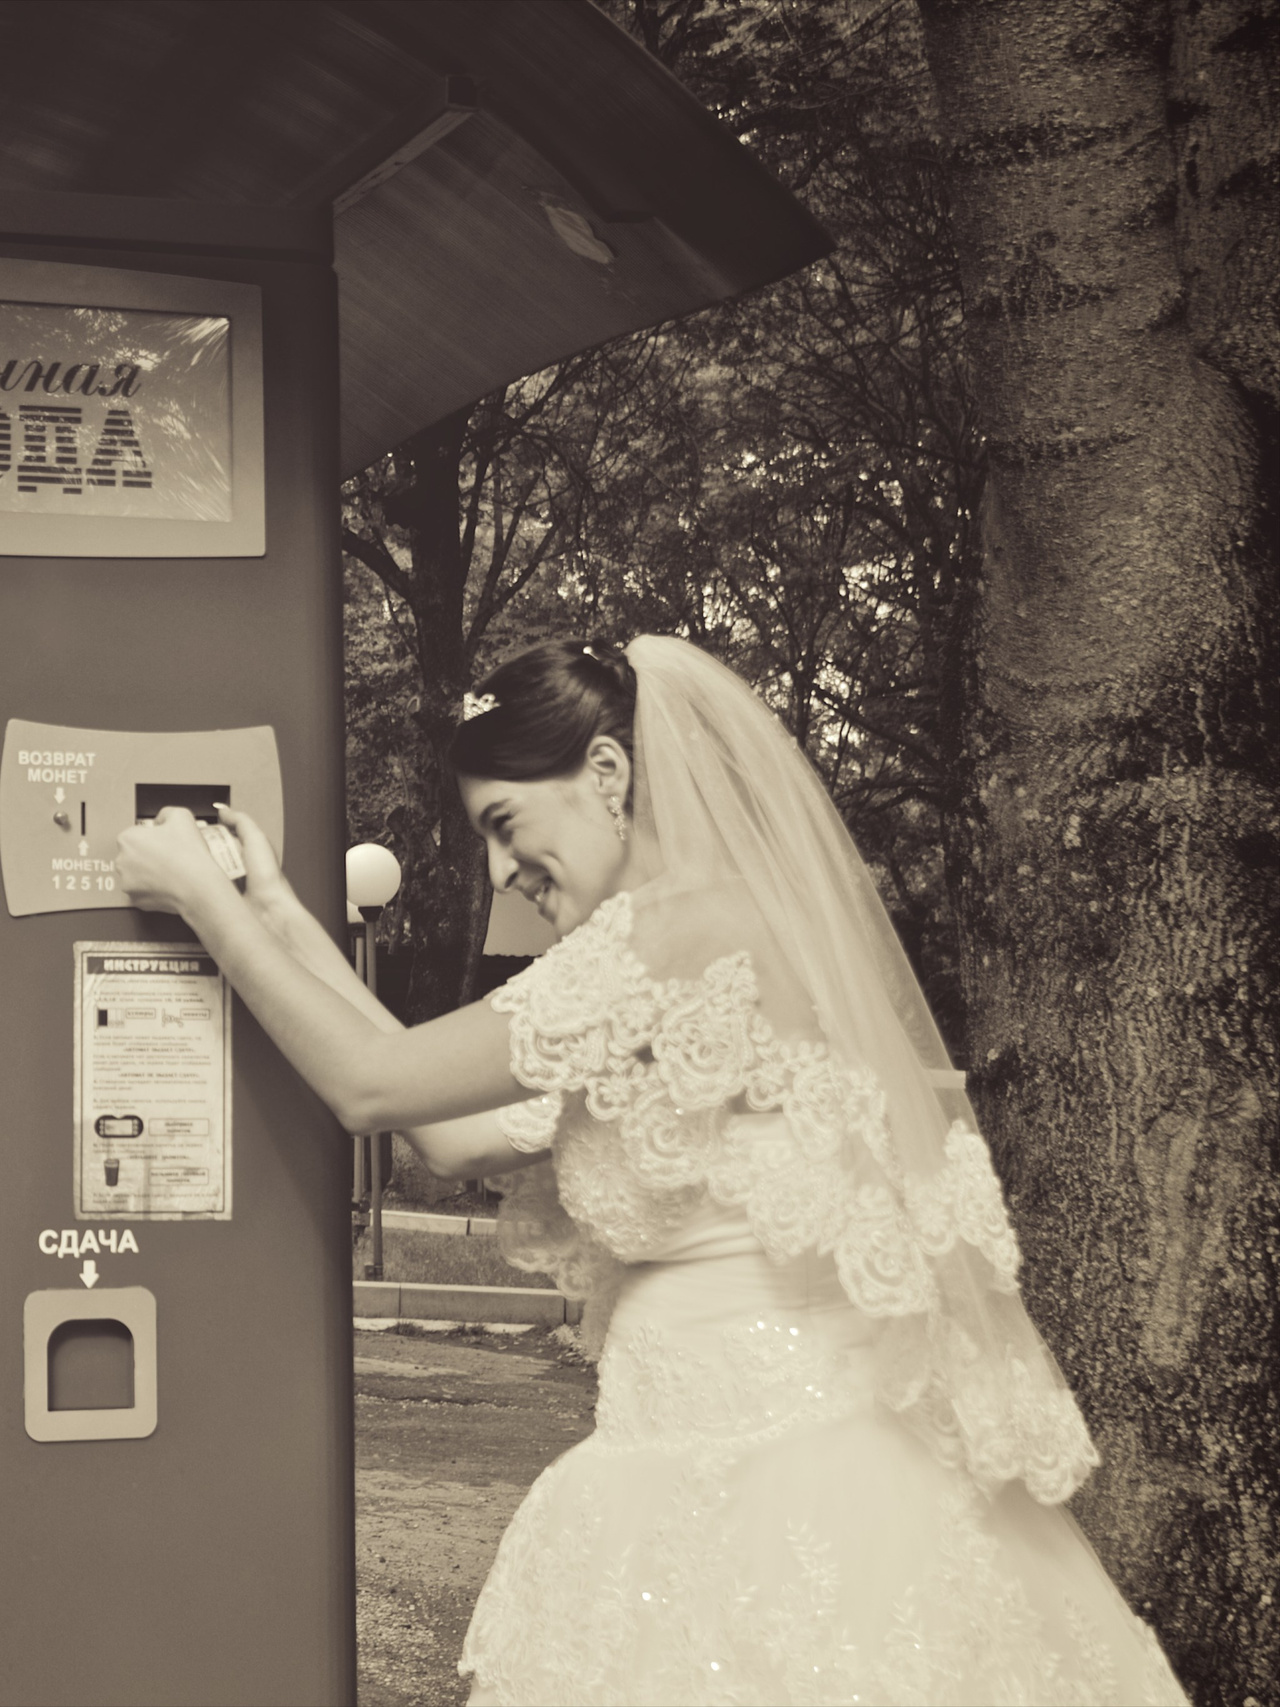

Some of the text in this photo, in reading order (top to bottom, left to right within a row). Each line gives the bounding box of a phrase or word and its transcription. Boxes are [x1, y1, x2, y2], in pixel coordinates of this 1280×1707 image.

[18, 750, 96, 767] ВОЗВРАТ
[27, 767, 88, 784] МОНЕТ
[51, 858, 114, 872] МОНЕТЫ
[52, 874, 115, 892] 1 2 5 10
[103, 958, 200, 974] ИНСТРУКЦИЯ
[38, 1229, 139, 1259] СДАЧА
